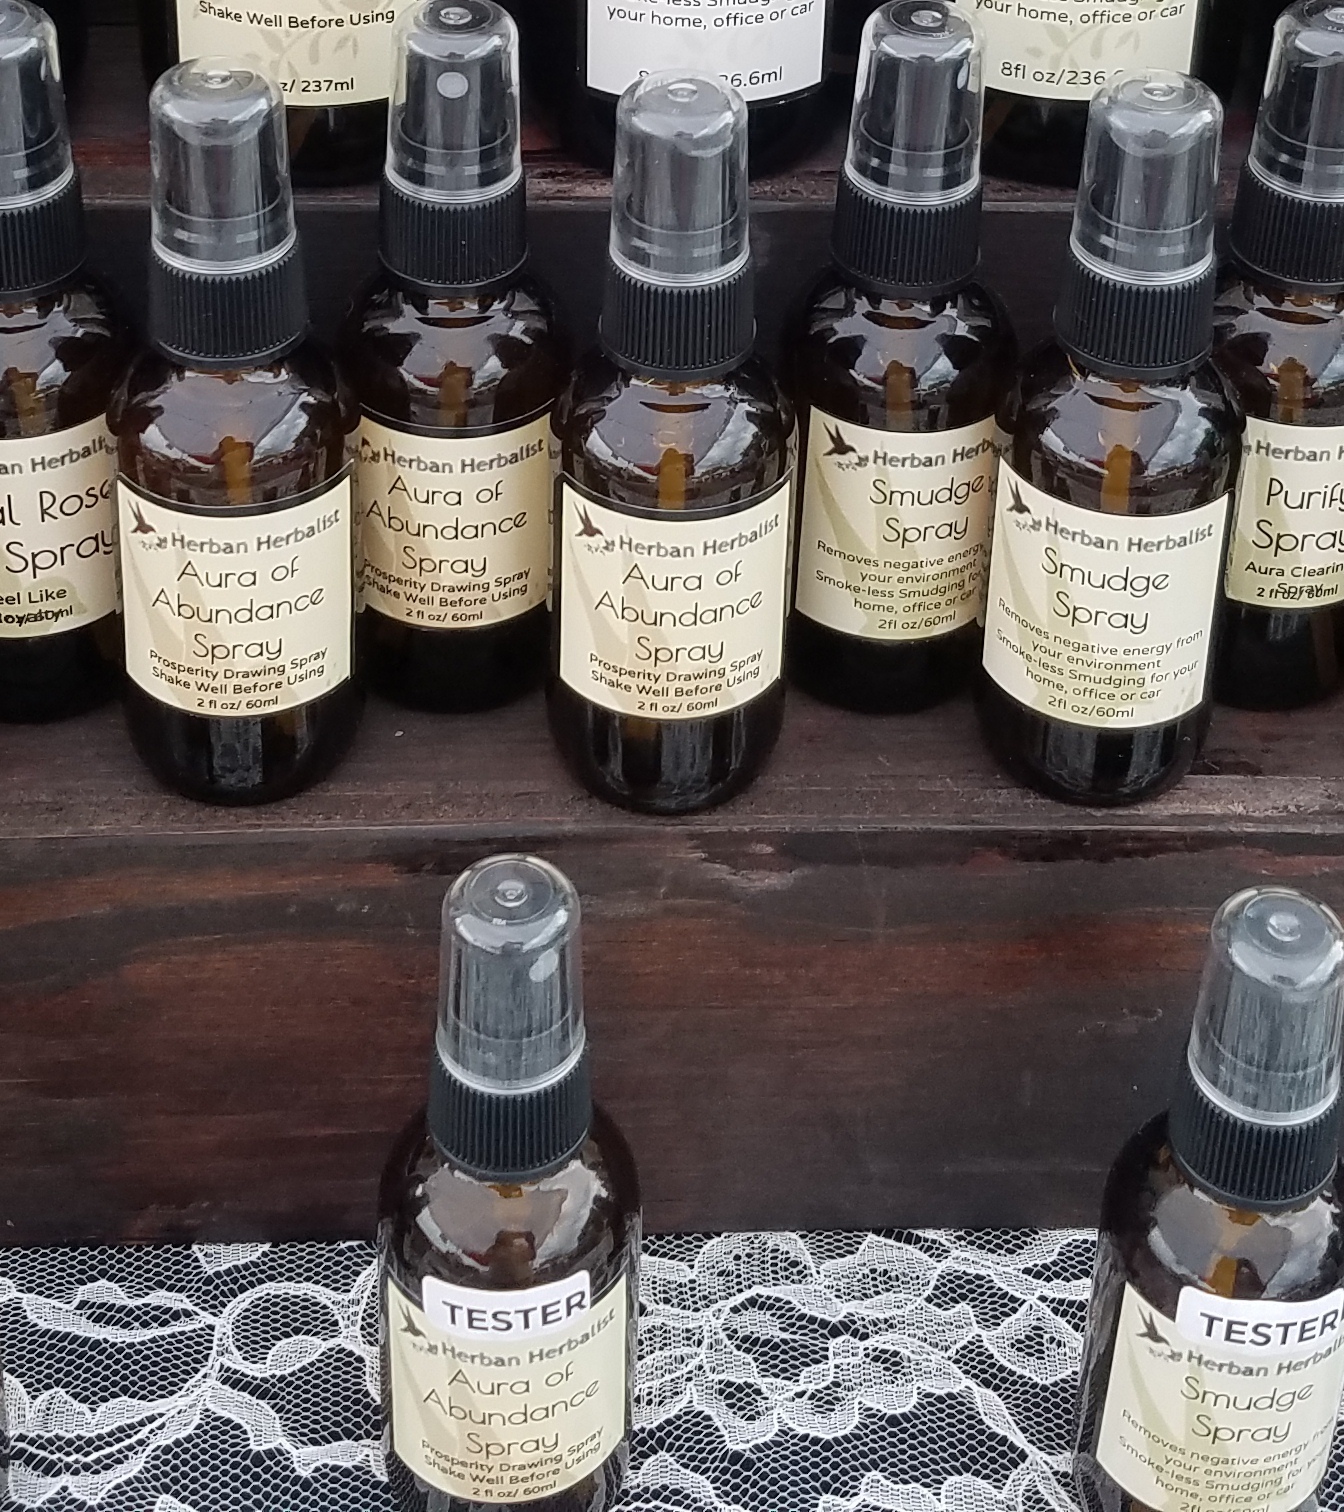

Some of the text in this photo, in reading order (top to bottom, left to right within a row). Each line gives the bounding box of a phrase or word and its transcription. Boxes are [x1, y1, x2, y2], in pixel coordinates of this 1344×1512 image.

[607, 0, 814, 30] your home, office or car
[388, 475, 504, 507] Aura of
[870, 475, 984, 506] Smudge
[366, 501, 527, 541] Abundance
[619, 513, 780, 558] Herban Herbalist
[883, 517, 969, 548] Spray
[1046, 517, 1213, 552] Herban Herbalist
[401, 545, 487, 577] Spray
[622, 561, 743, 591] Aura of
[1042, 547, 1170, 598] Smudge
[595, 590, 763, 628] Abundance
[1053, 591, 1149, 634] Spray
[635, 636, 724, 667] Spray
[1054, 635, 1172, 656] negative energy
[442, 1290, 588, 1331] TESTER
[1200, 1308, 1339, 1347] TESTER
[448, 1361, 574, 1396] Aura of
[1180, 1376, 1314, 1413] Smudge
[423, 1380, 600, 1426] Abundance
[466, 1432, 559, 1459] Spray
[1192, 1414, 1292, 1444] Spray
